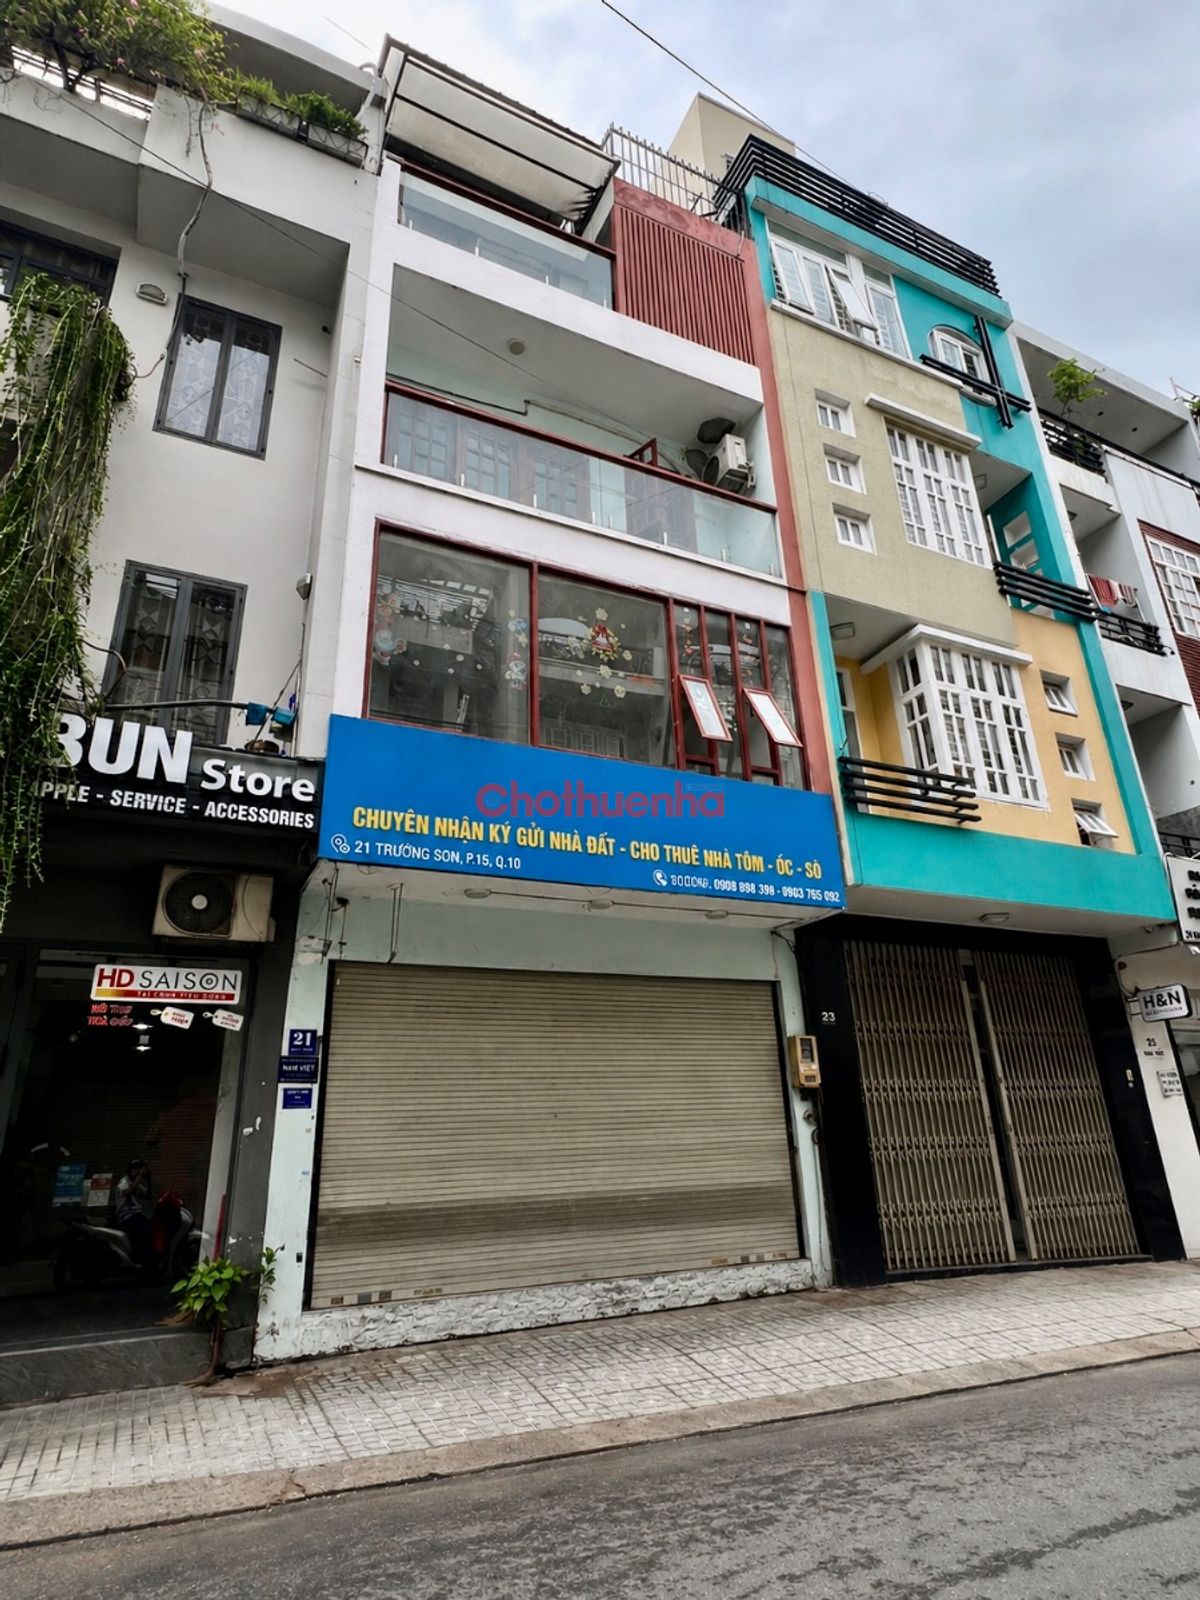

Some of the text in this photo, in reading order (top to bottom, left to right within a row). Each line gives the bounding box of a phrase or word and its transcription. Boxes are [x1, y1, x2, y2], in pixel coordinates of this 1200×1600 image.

[50, 712, 316, 802] BUN Store
[109, 789, 187, 814] SERVICE
[204, 801, 315, 829] ACCESSORIES
[353, 806, 429, 835] CHUYÊN
[434, 815, 484, 844] NHẬN
[489, 821, 511, 846] KÝ
[516, 822, 545, 848] GỬI
[549, 829, 583, 853] NHÀ
[586, 832, 616, 857] ĐẤT
[630, 840, 660, 862] CHO
[663, 844, 700, 866] THUÊ
[703, 848, 732, 870] NHÀ
[735, 850, 765, 873] TÔM
[776, 853, 794, 876] ÓC
[805, 858, 823, 880] SÒ
[354, 840, 371, 855] 21
[466, 852, 493, 868] P.15,
[495, 855, 522, 870] Q.10
[96, 967, 238, 991] HD SAISON
[1143, 990, 1181, 1009] H&N
[821, 1011, 836, 1022] 23
[293, 1031, 312, 1046] 21
